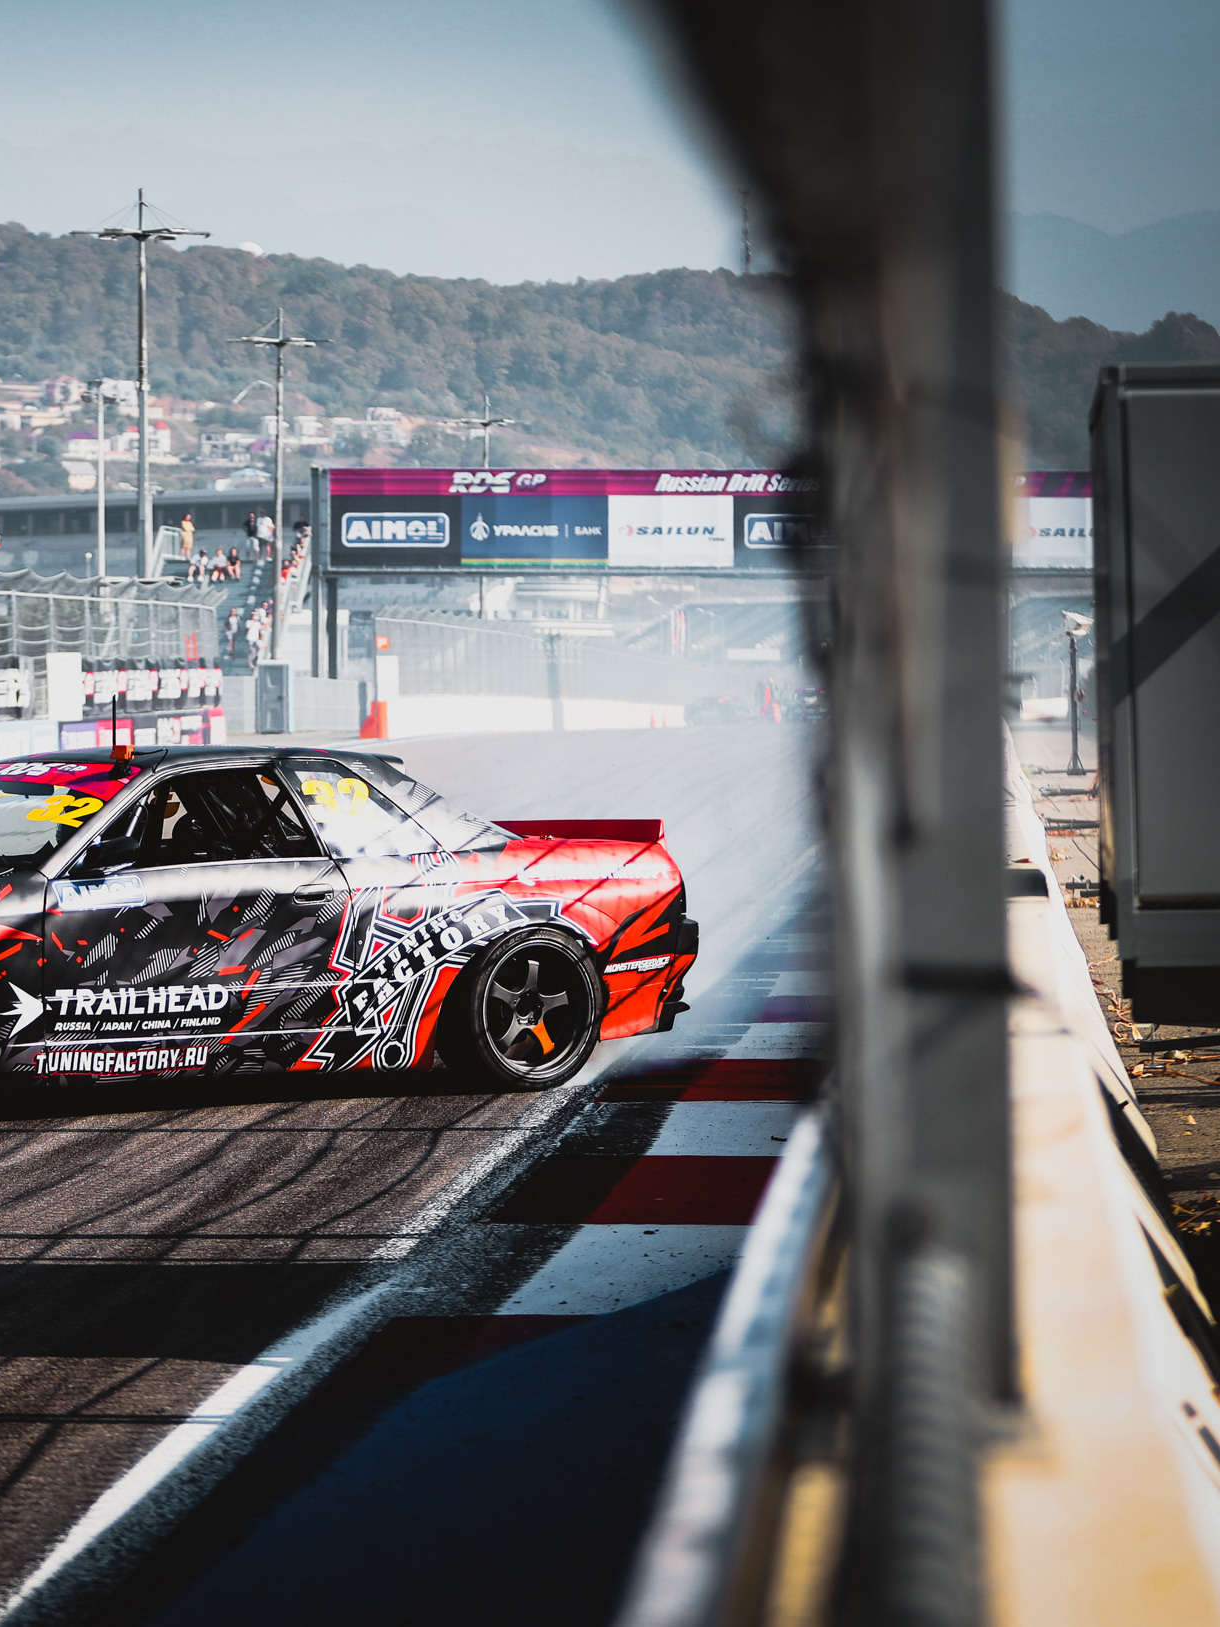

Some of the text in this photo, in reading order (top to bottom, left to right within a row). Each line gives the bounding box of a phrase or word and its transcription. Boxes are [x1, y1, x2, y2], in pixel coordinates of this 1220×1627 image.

[449, 471, 547, 494] RDS GP
[654, 473, 727, 492] Russian
[728, 473, 769, 493] Drift
[346, 519, 445, 541] AIMOL
[493, 524, 603, 538] УРАЛСИБ БАНК
[636, 526, 716, 536] SAILUN
[748, 520, 822, 542] AIM
[25, 794, 104, 828] 32
[374, 909, 464, 976] TUNING
[352, 904, 511, 1012] FACTORY
[603, 956, 671, 974] MONSTERSERVICE
[54, 983, 230, 1016] TRAILHEAD
[54, 1021, 91, 1032] RUSSIA
[100, 1021, 133, 1032] JAPAN
[141, 1019, 171, 1030] CHINA
[180, 1017, 221, 1028] FINLAND
[35, 1046, 210, 1075] TUNINGFACTORY.RU
